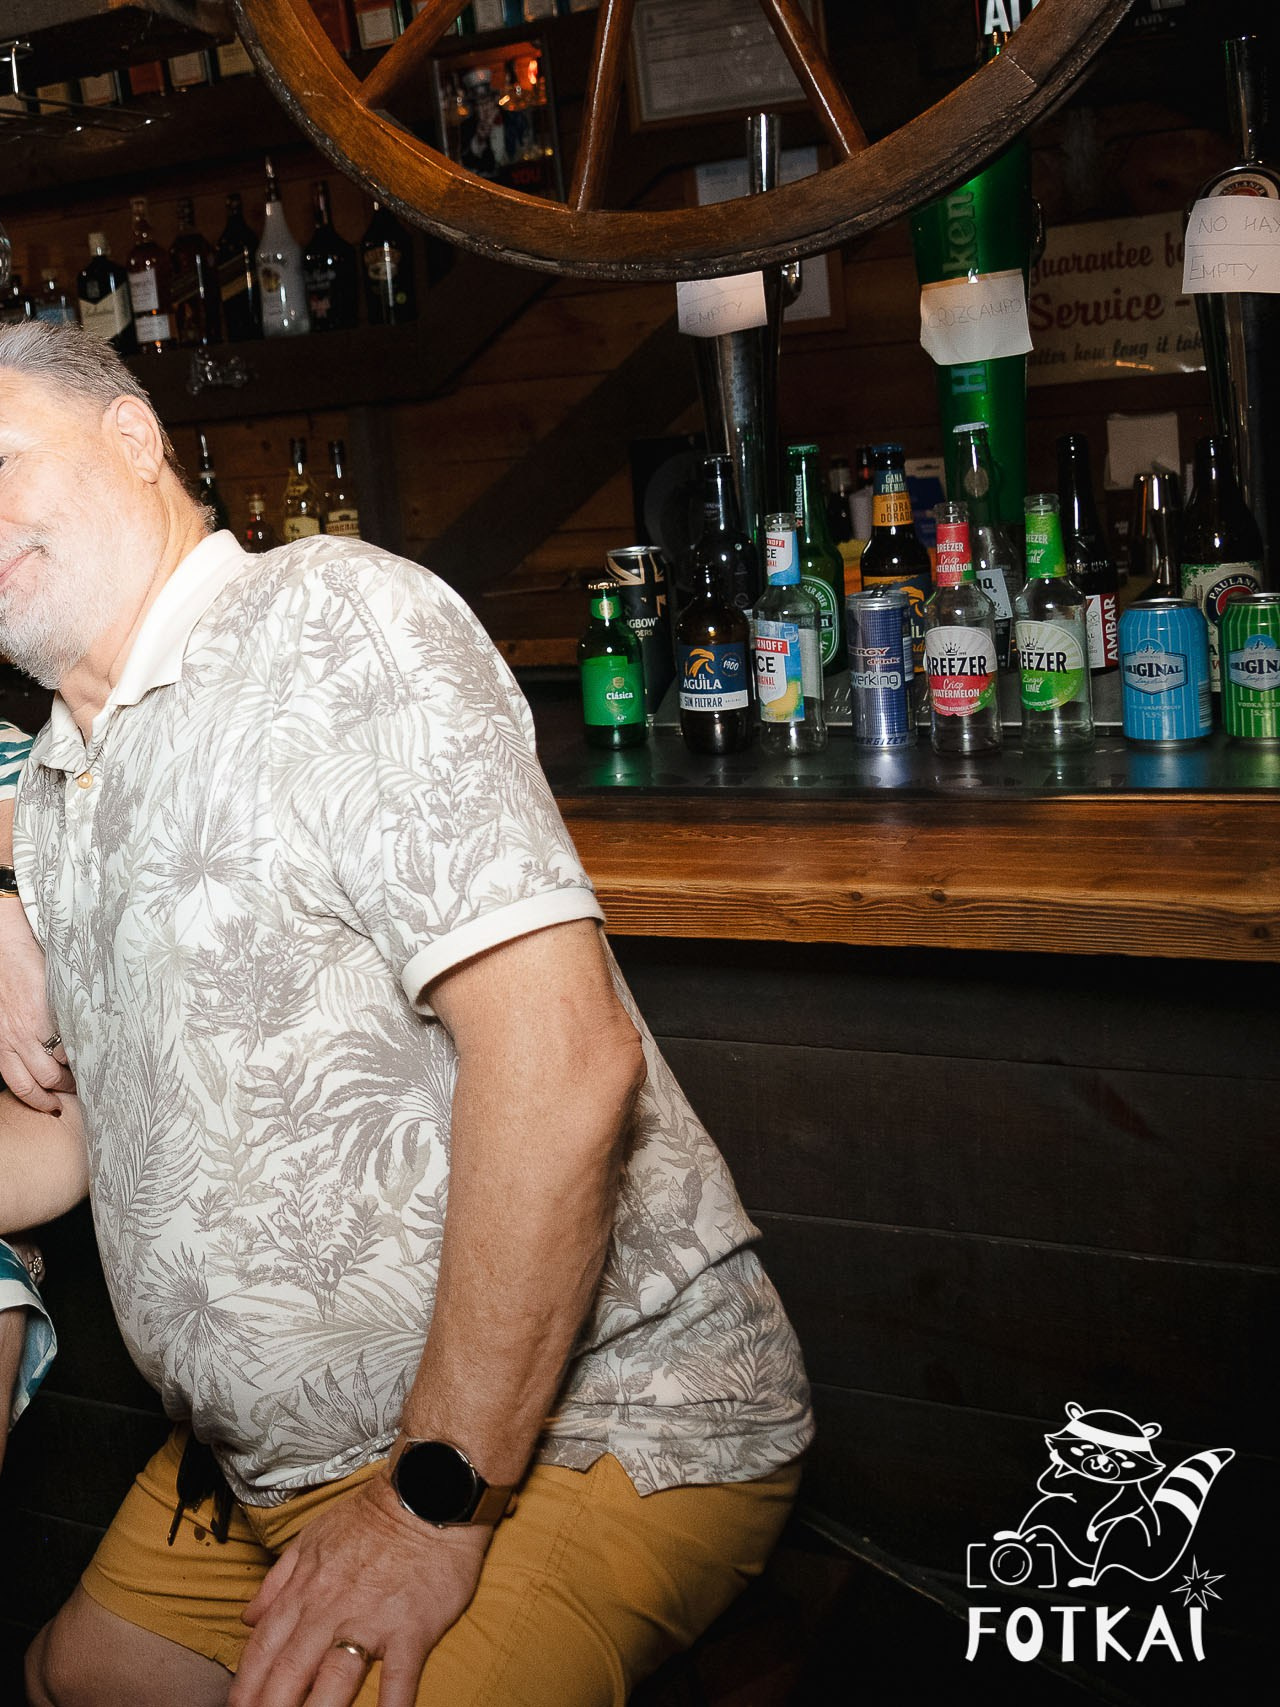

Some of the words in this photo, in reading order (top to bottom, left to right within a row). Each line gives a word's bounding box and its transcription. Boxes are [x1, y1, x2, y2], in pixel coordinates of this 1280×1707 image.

[1199, 216, 1228, 234] NO
[1190, 256, 1258, 280] EMPTY
[686, 302, 742, 328] EMPTY
[1029, 287, 1165, 332] Service
[794, 474, 803, 519] Heineken
[1209, 576, 1259, 601] PAULANE
[1103, 595, 1119, 661] AMBAR
[926, 655, 988, 677] BREEZER
[1231, 658, 1280, 675] ORIGIN
[606, 691, 634, 701] Clásica
[694, 696, 723, 708] FILTRAR
[932, 688, 980, 699] WATERMELON
